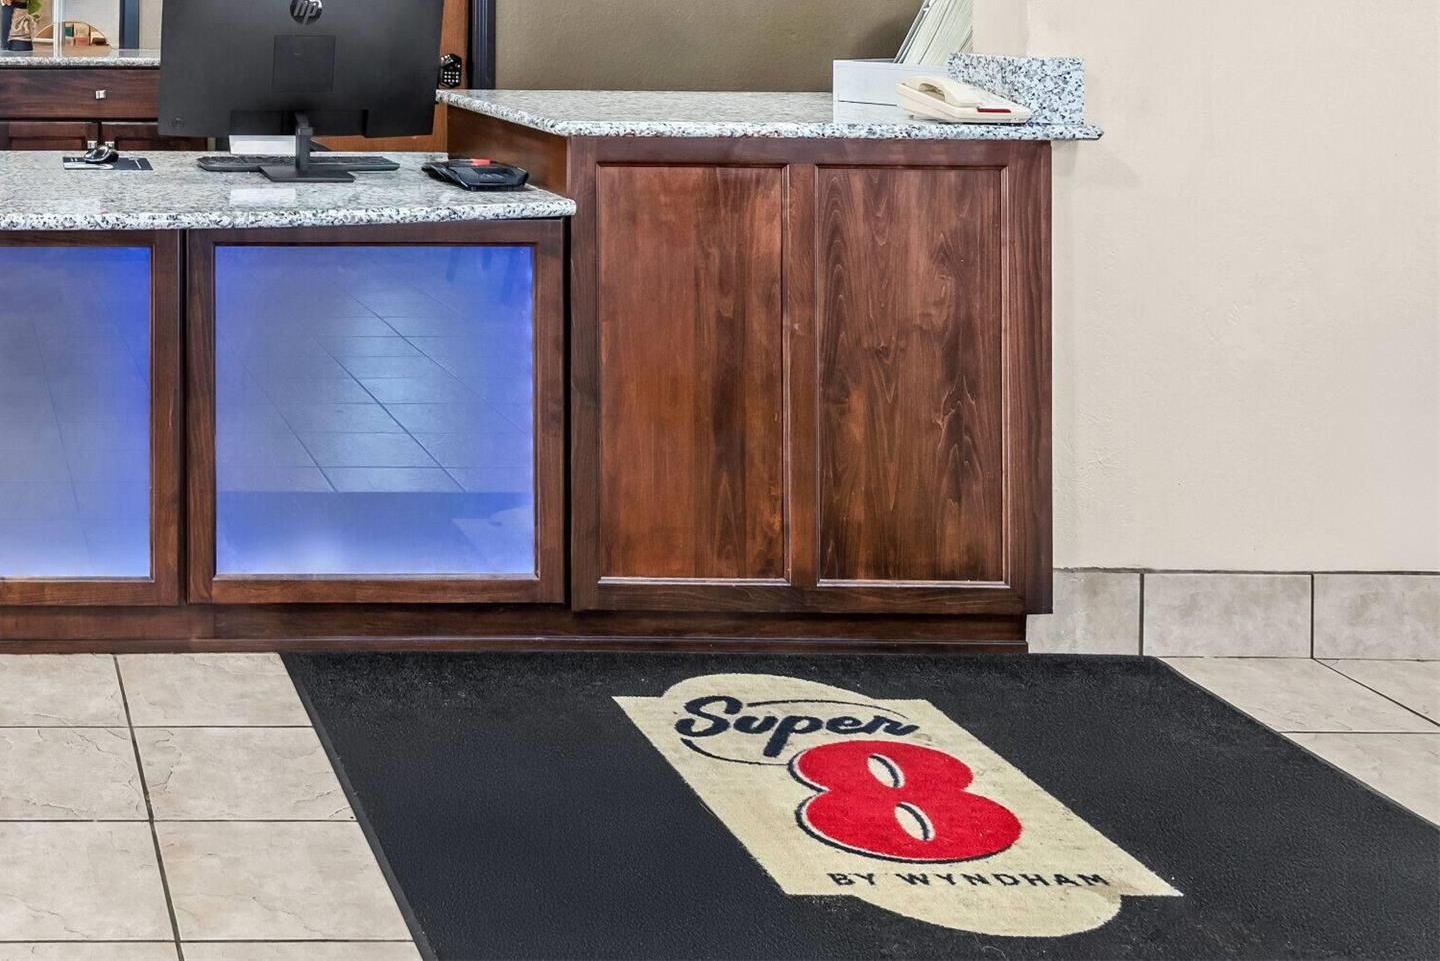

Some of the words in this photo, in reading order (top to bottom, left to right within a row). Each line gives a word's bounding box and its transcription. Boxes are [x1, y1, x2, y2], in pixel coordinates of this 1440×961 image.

[674, 695, 920, 758] Super
[787, 739, 1023, 864] 8
[831, 872, 877, 887] BY
[897, 872, 1111, 887] WYNDHAM
